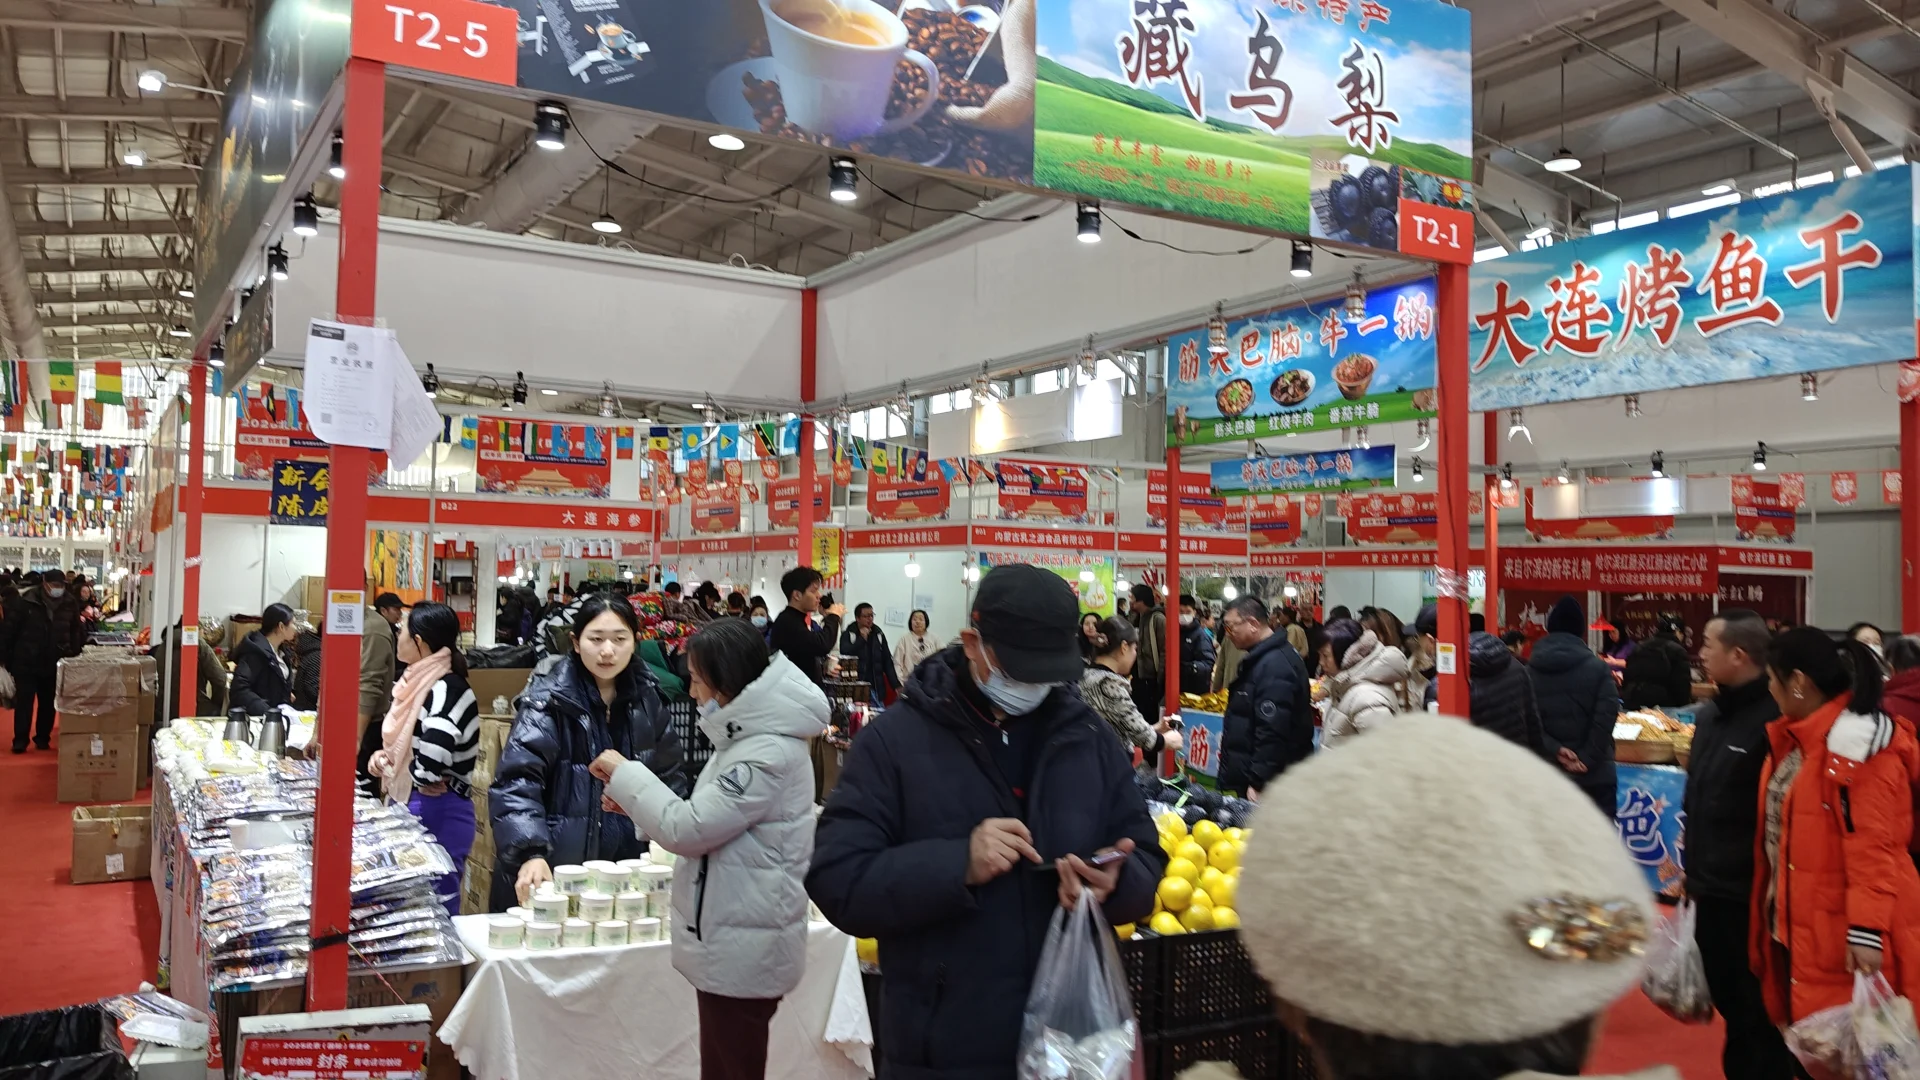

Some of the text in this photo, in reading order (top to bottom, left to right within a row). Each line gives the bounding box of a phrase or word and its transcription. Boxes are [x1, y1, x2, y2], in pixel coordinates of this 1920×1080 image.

[385, 4, 489, 59] T2-5
[1118, 0, 1399, 154] 藏乌梨
[1412, 215, 1461, 249] T2-1
[1472, 210, 1883, 374] 大连烤鱼干
[1268, 411, 1315, 431] 红烧牛肉
[278, 465, 329, 492] 新会
[441, 502, 458, 511] B22
[561, 510, 642, 529] 大连海参
[994, 531, 1094, 547] 内蒙古乳之源食品有限公司
[1159, 538, 1208, 553] 黄亚麻籽
[1504, 557, 1592, 580] 来自尔滨的新年礼物
[317, 1053, 349, 1069] 封条
